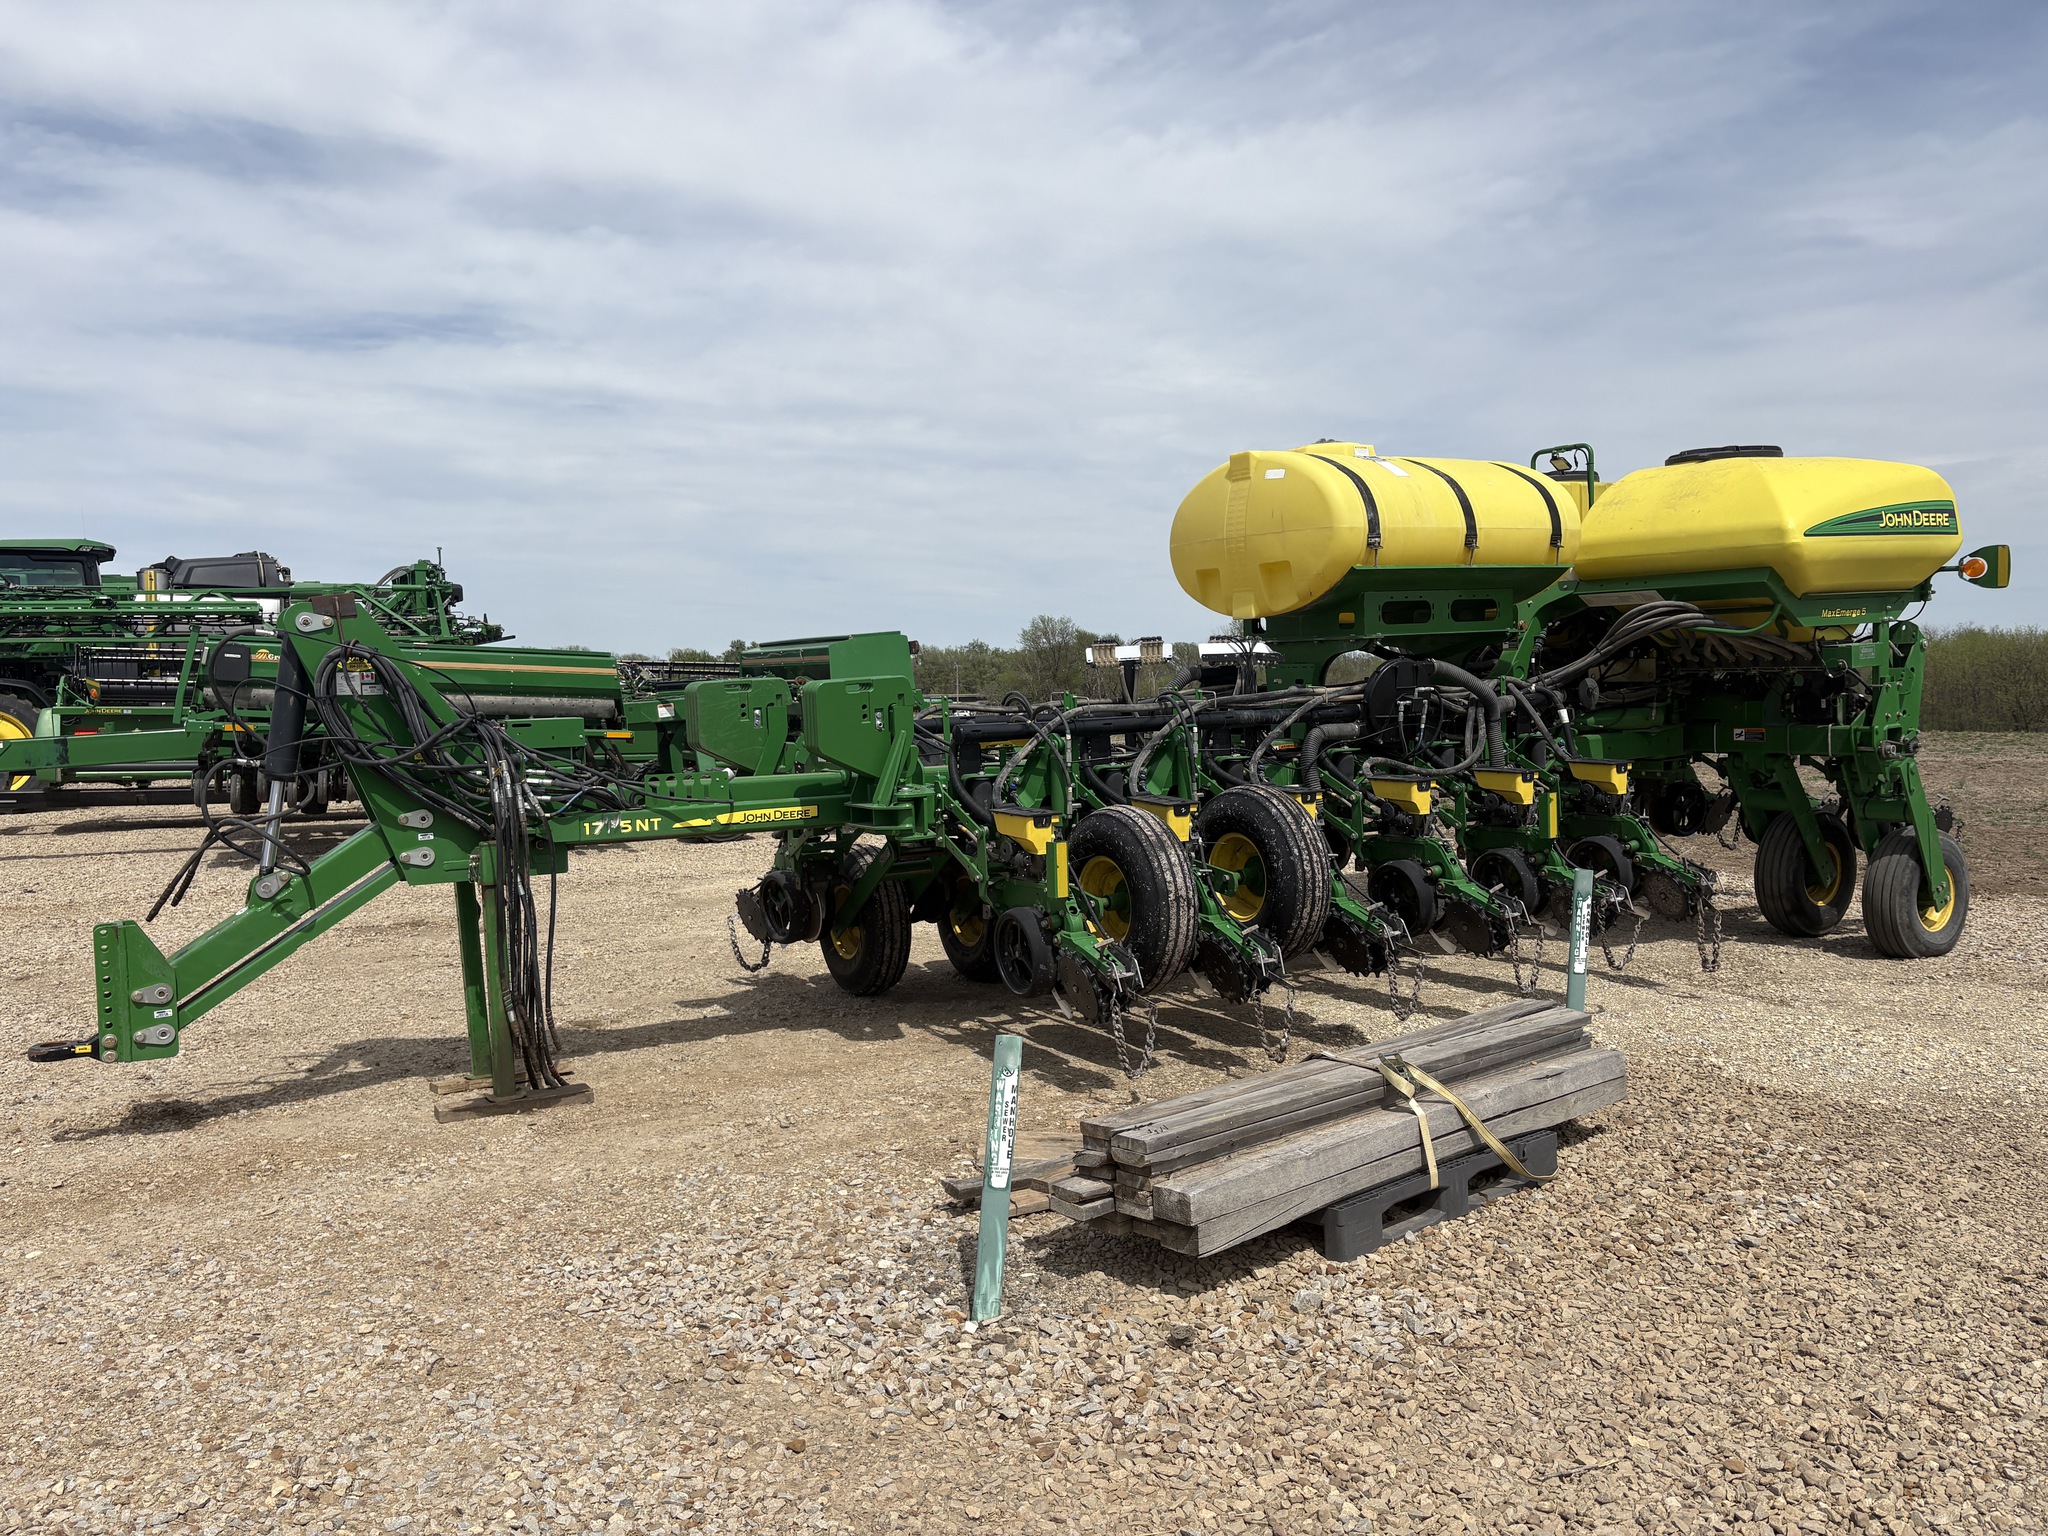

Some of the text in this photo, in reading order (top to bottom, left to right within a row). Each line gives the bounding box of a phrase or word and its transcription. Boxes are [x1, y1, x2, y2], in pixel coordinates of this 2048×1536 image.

[1879, 510, 1950, 528] JOHN DEERE
[1821, 607, 1867, 618] MaxEmerge 5
[740, 809, 811, 823] JOHN DEERE
[1001, 1100, 1009, 1142] SEWER
[1006, 1084, 1018, 1160] MANHOLE
